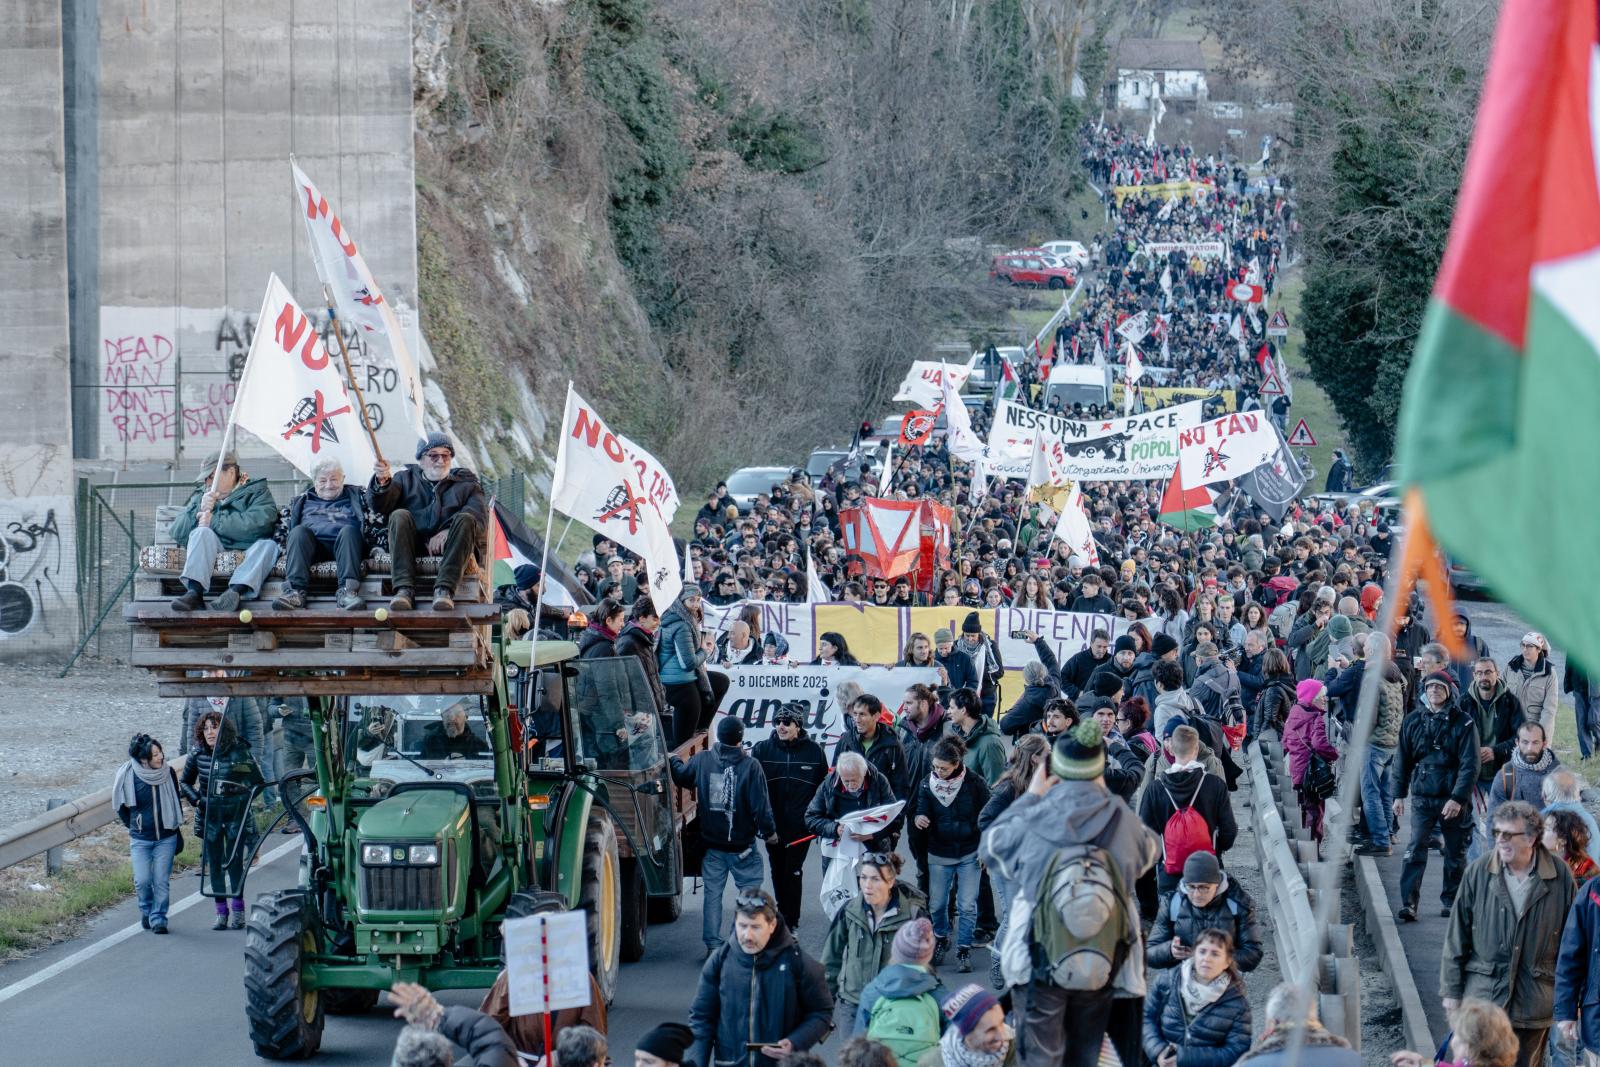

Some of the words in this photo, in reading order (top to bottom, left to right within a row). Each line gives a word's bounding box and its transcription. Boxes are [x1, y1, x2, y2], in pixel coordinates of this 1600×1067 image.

[104, 335, 173, 365] DEAD
[105, 363, 162, 386] MAN
[106, 386, 174, 413] DON'T
[112, 412, 180, 444] RAPE
[572, 408, 625, 463] NO
[1126, 412, 1178, 433] PACE
[1180, 426, 1206, 449] NO
[1215, 413, 1258, 438] TAV
[738, 675, 745, 688] 8
[748, 675, 800, 688] DICEMBRE
[802, 676, 828, 688] 2025
